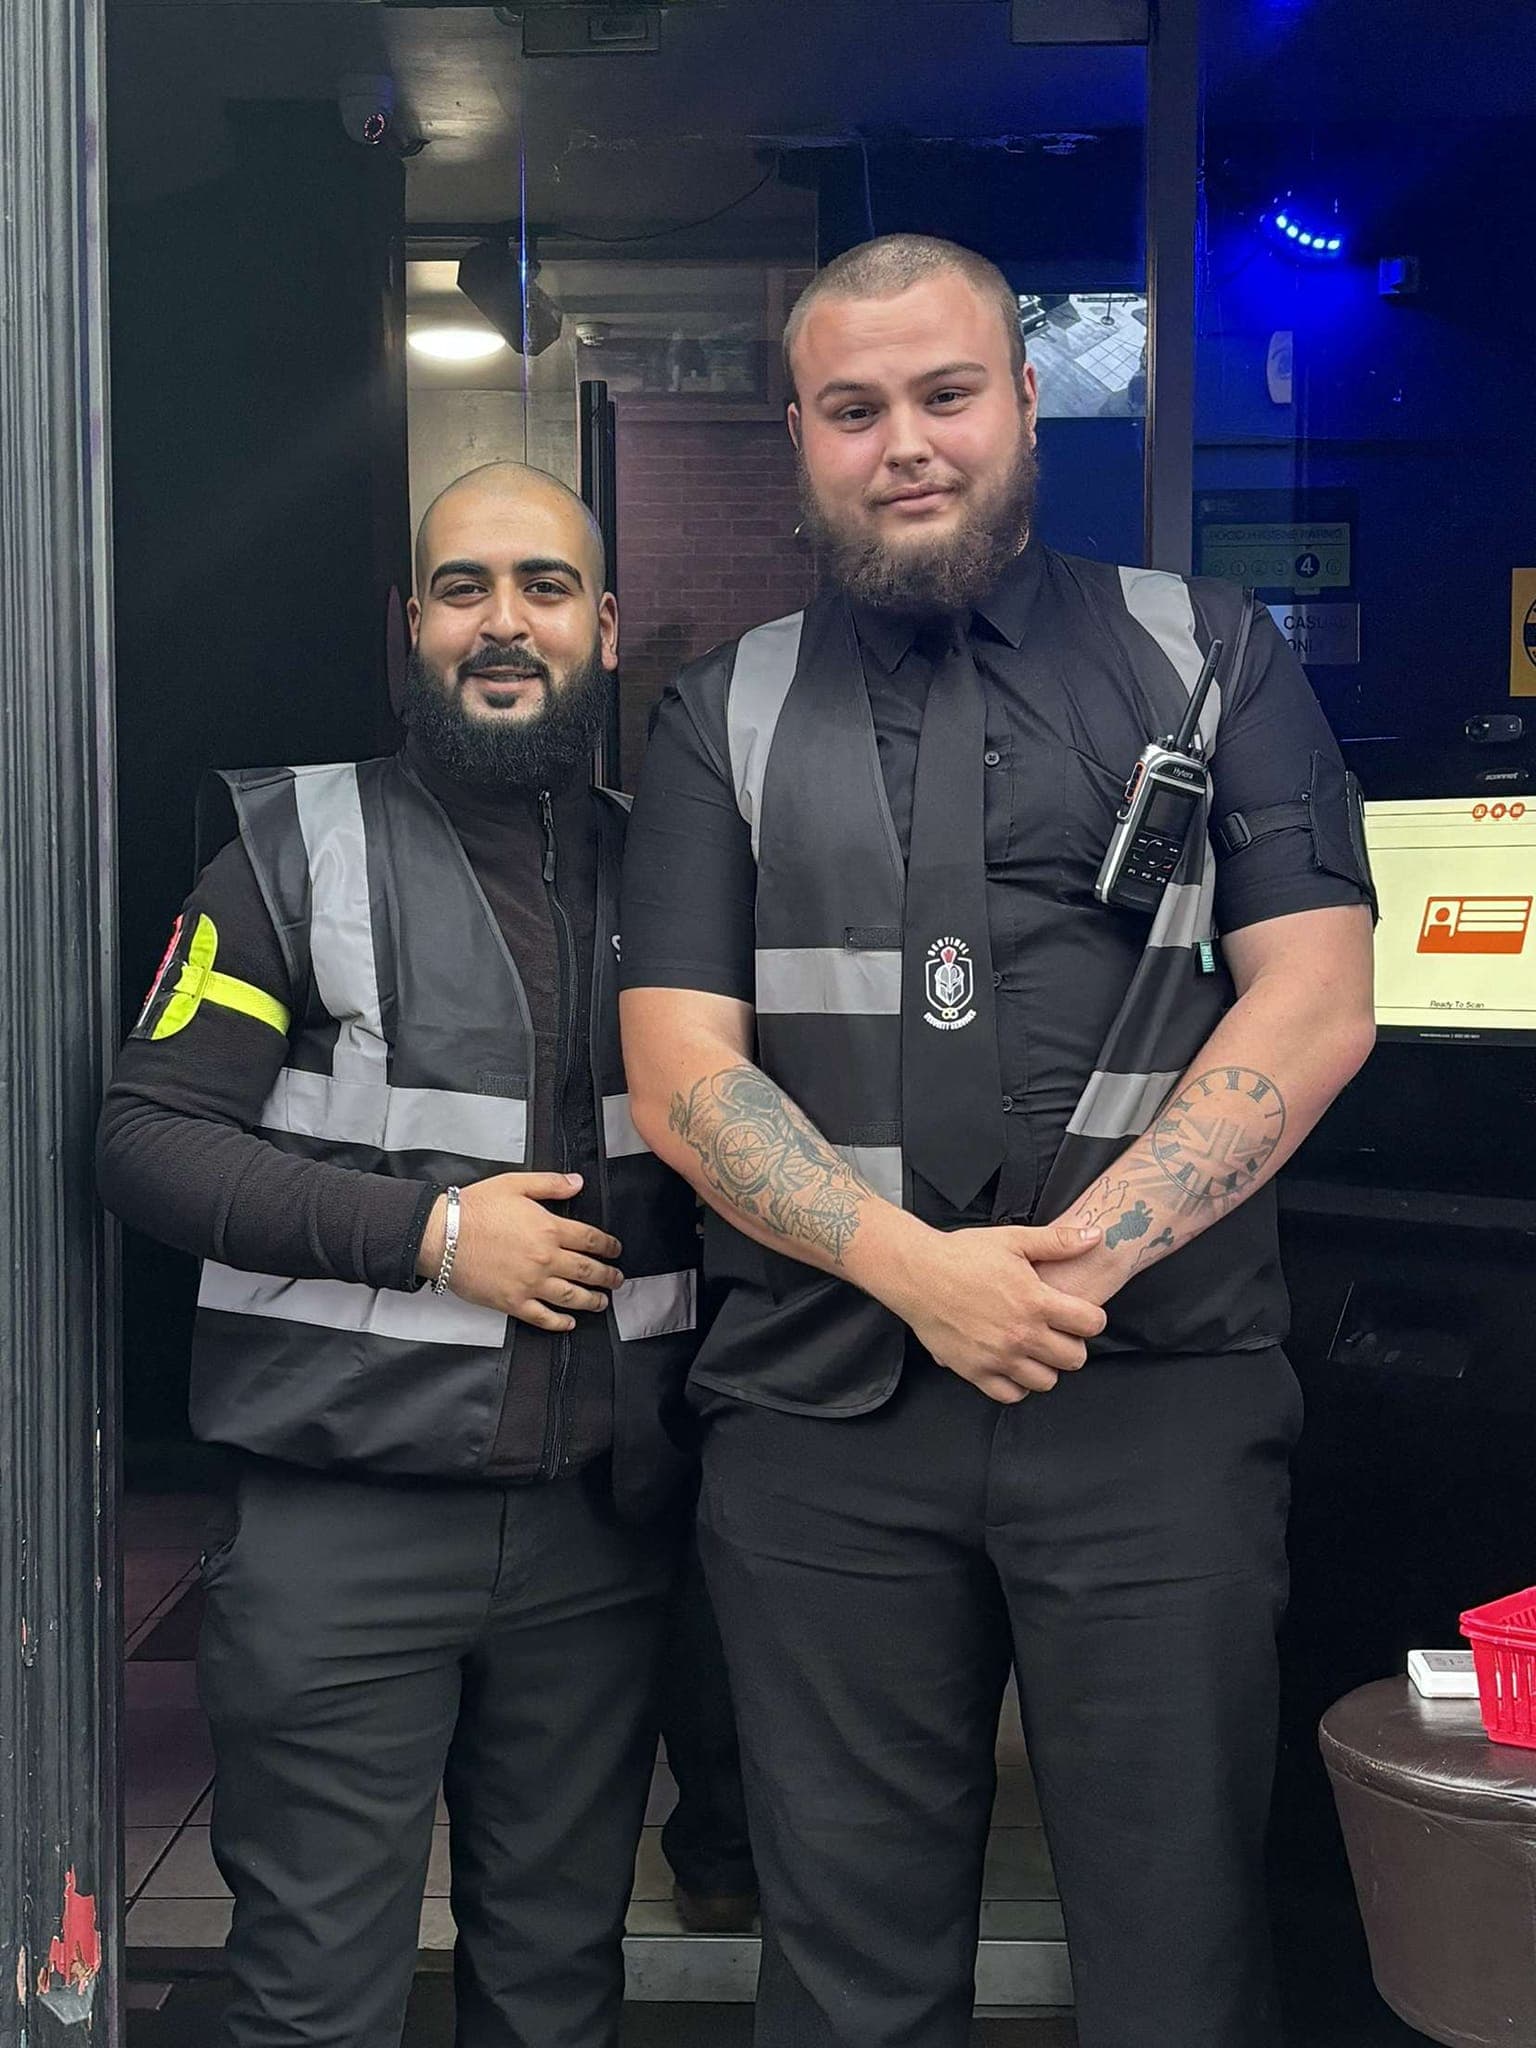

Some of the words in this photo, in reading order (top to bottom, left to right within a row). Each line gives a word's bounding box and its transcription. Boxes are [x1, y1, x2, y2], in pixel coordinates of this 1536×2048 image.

[1300, 556, 1314, 574] 4
[1172, 767, 1194, 780] Hytera
[1430, 1000, 1453, 1010] Ready
[1455, 1000, 1464, 1008] To
[1466, 1001, 1485, 1009] Scan
